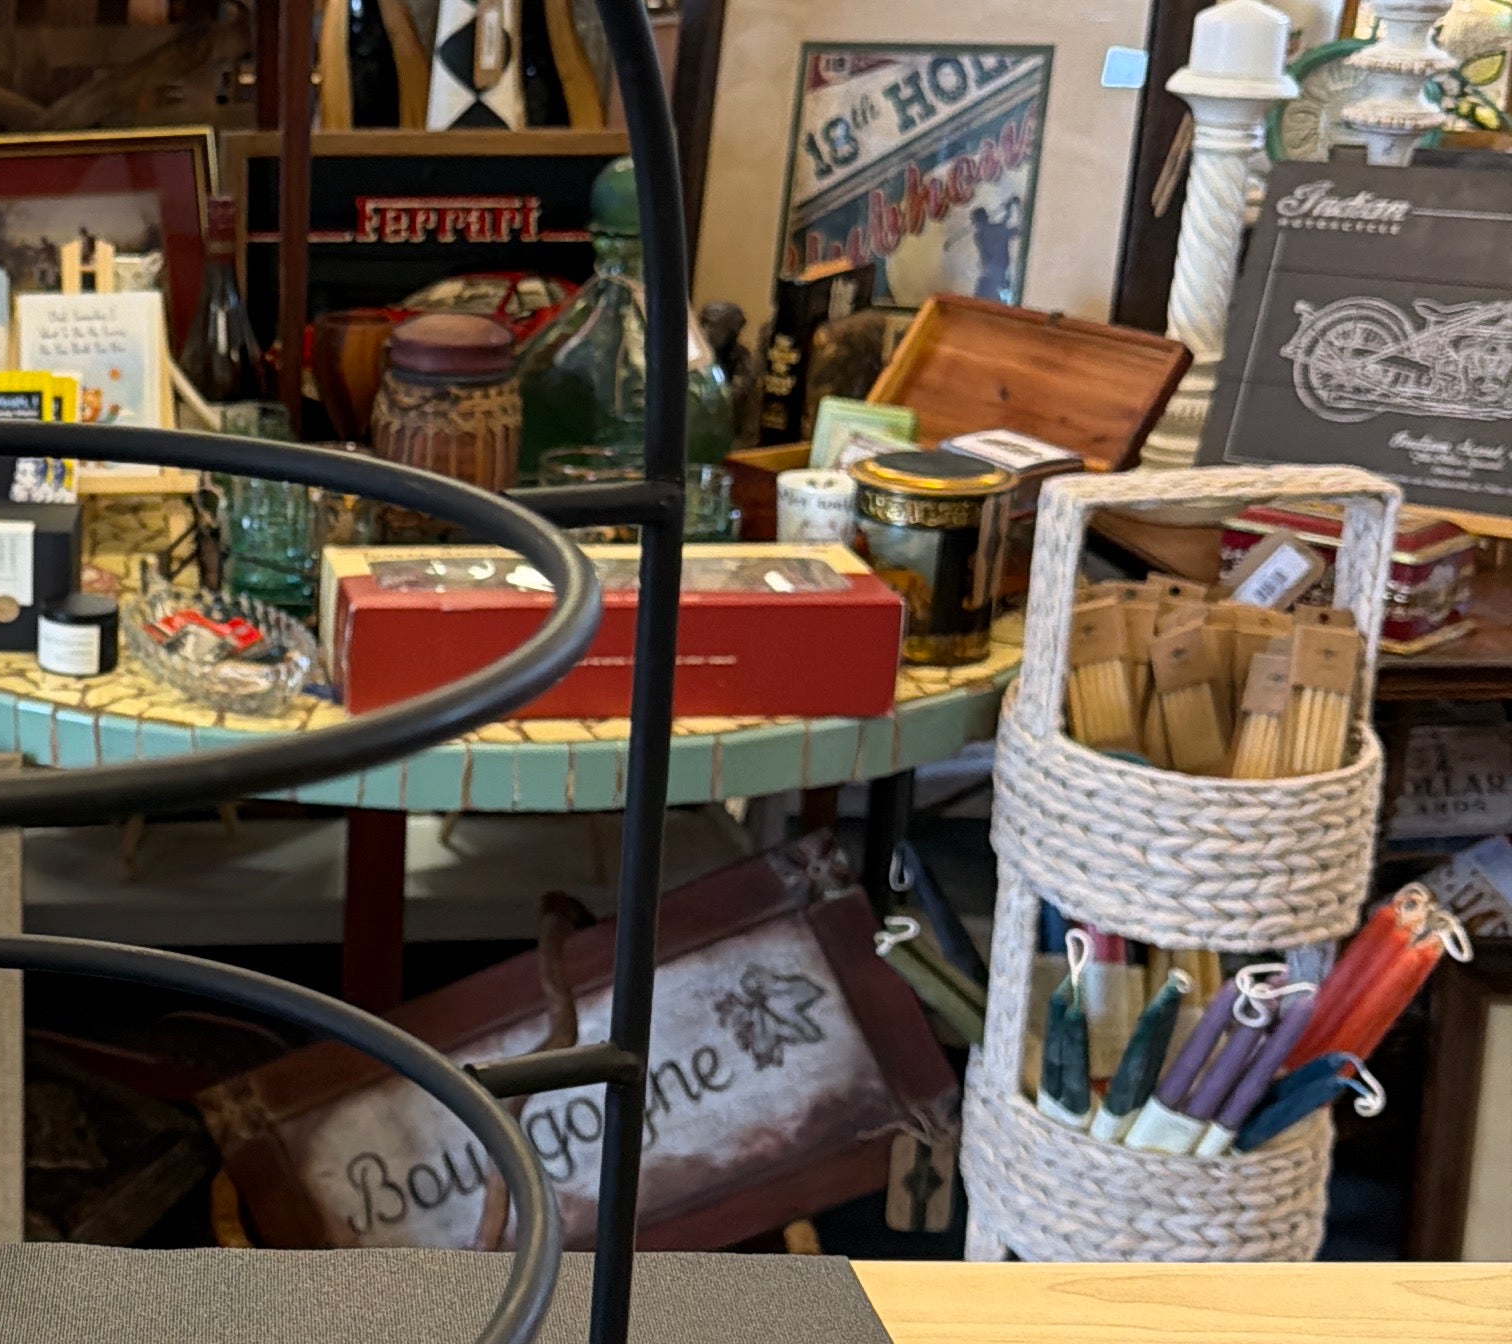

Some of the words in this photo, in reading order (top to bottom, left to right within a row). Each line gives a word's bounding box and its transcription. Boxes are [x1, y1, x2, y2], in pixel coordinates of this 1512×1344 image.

[804, 93, 881, 180] 18th
[882, 54, 1036, 133] HOL
[355, 196, 542, 243] Ferrari
[1276, 179, 1412, 222] Indian
[346, 1044, 735, 1236] Bougone
